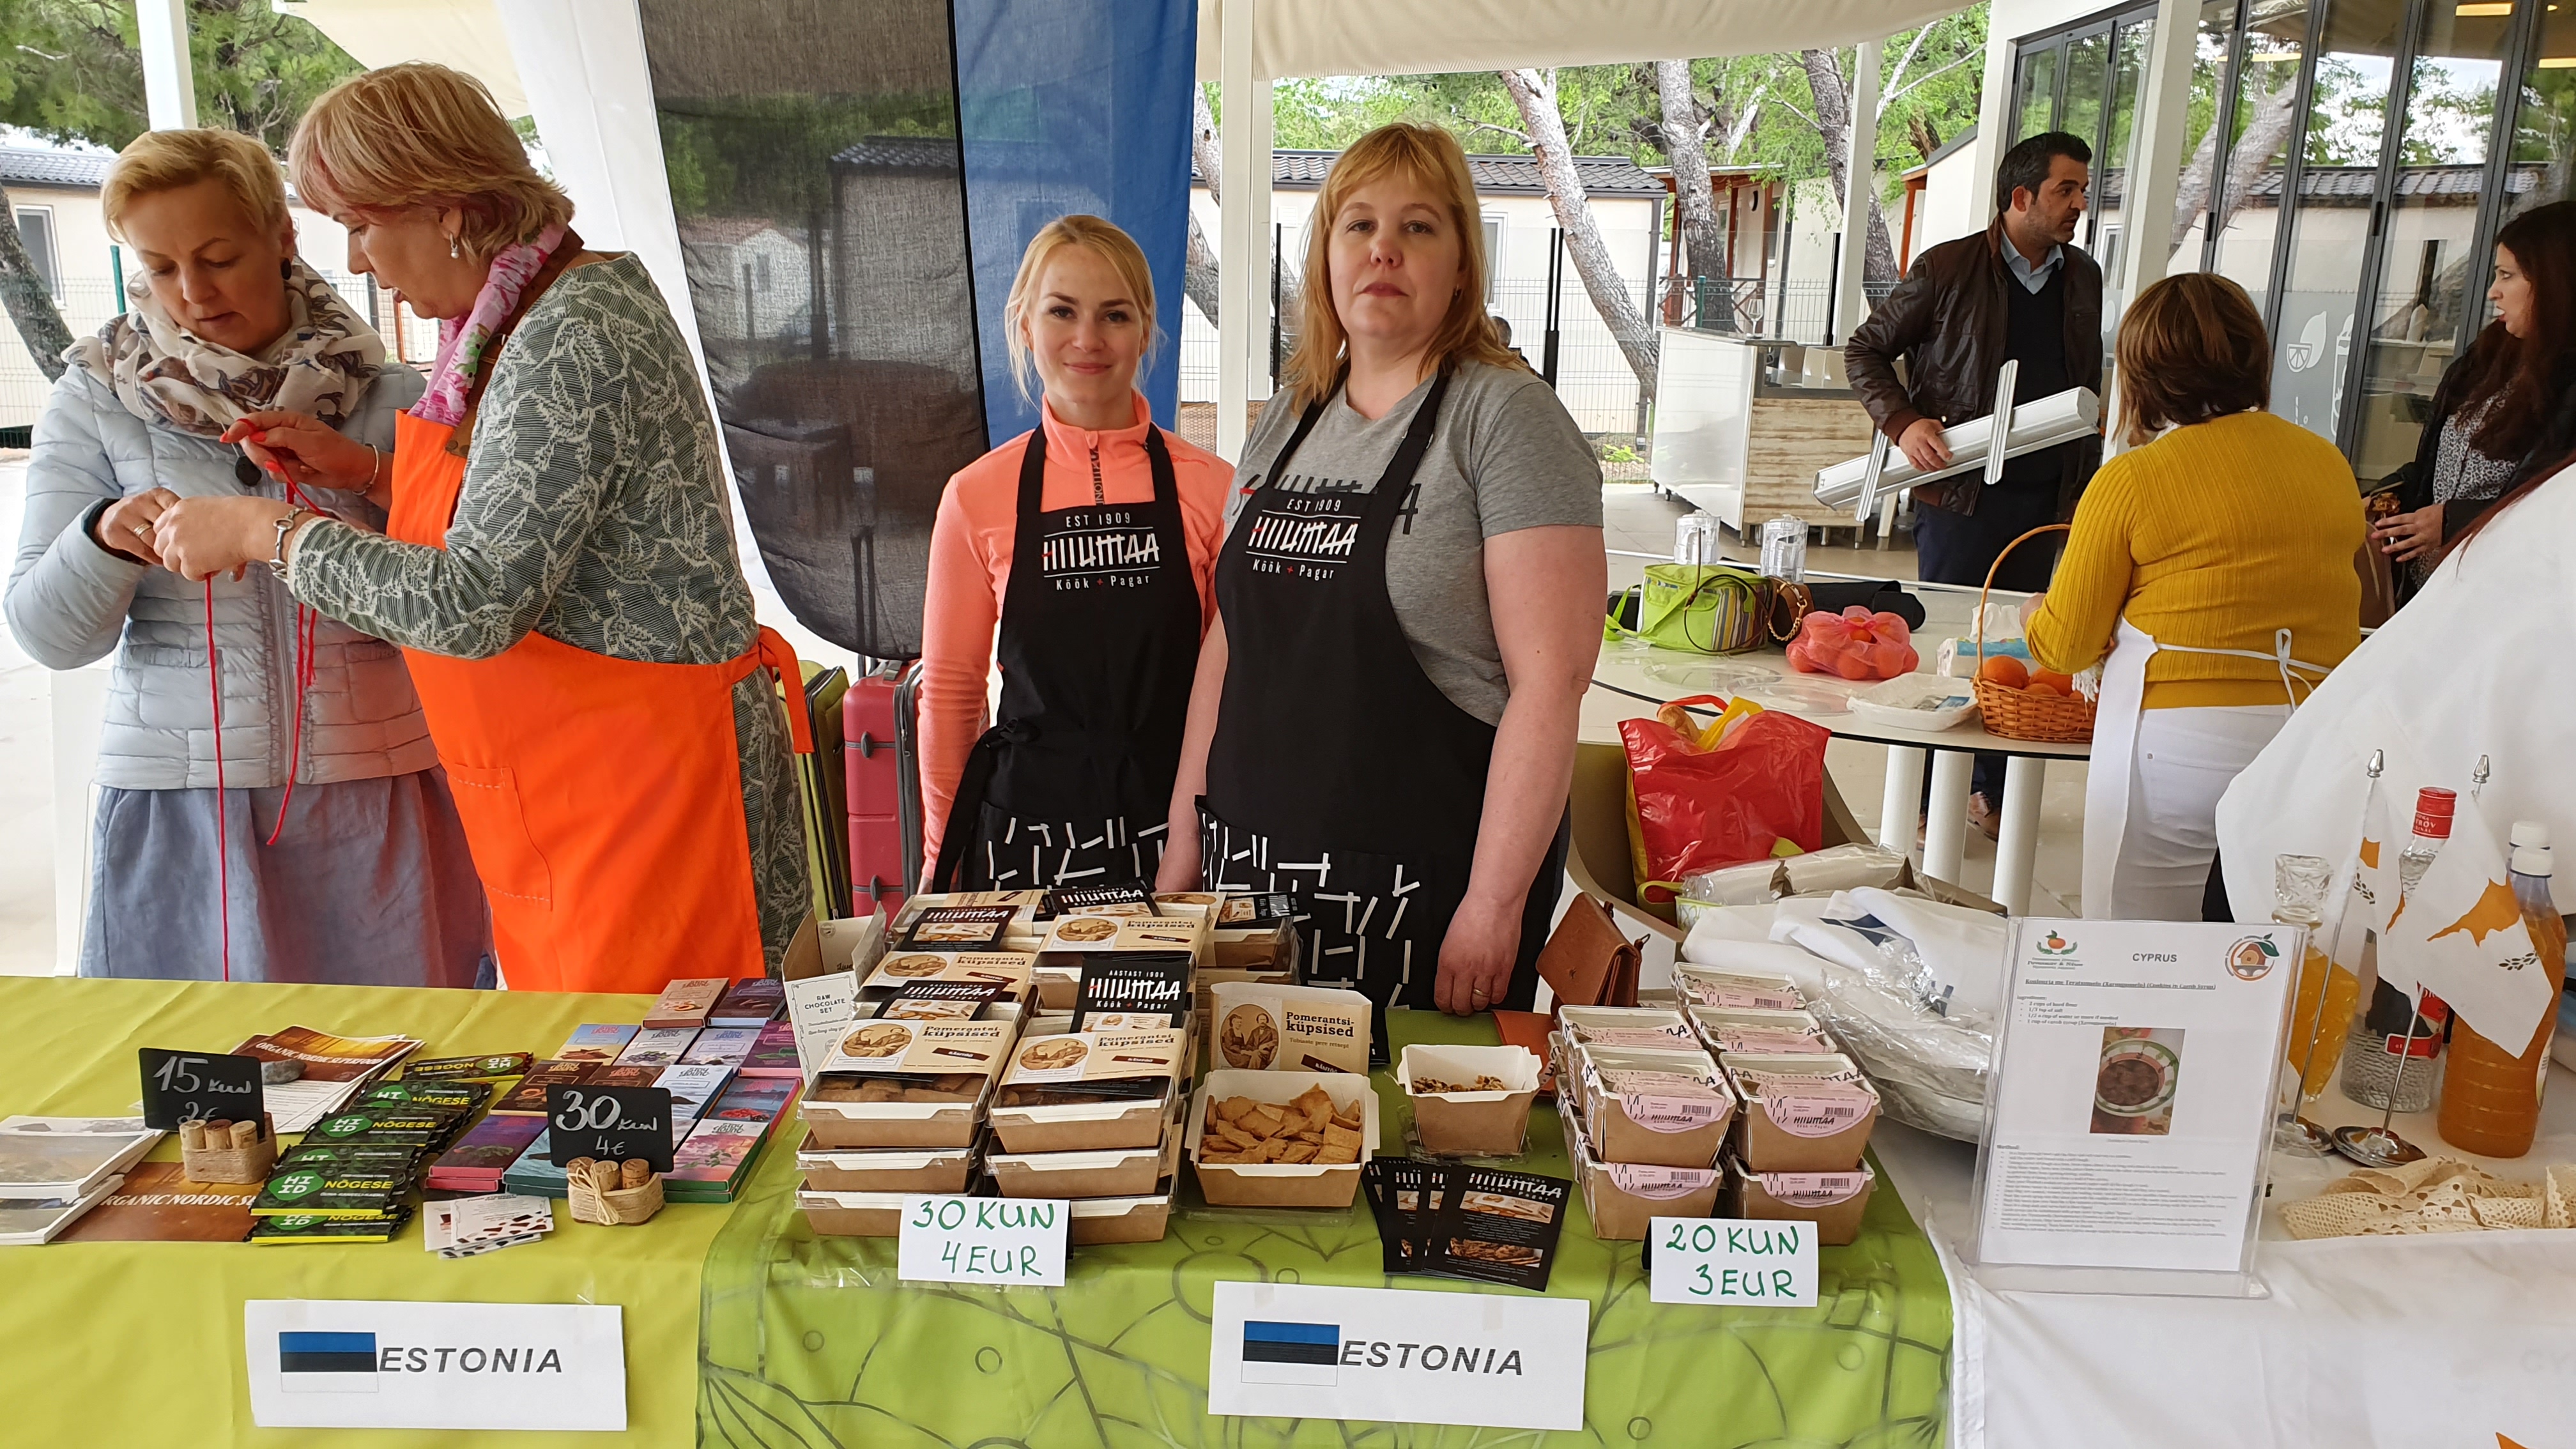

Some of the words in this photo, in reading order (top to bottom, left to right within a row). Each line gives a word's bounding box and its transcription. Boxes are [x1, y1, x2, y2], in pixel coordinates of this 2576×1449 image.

[1287, 498, 1311, 512] EST
[1315, 499, 1341, 512] 1909
[1066, 514, 1089, 527] EST
[1098, 512, 1130, 526] 1909
[1299, 564, 1335, 581] Pagar
[1110, 575, 1149, 588] Pagar
[2132, 953, 2177, 963] CYPRUS
[804, 998, 846, 1009] CHOCOLATE
[1137, 1001, 1167, 1011] Pagar
[1286, 1011, 1354, 1026] Pomerantsi-
[1285, 1020, 1354, 1037] küpsised
[1098, 1038, 1175, 1046] küpsised
[256, 1042, 299, 1058] ORGANIC
[153, 1055, 209, 1093] 15
[555, 1090, 622, 1131] 30
[284, 1176, 314, 1184] HI
[324, 1179, 394, 1189] NÕGESE
[278, 1184, 307, 1193] ID
[100, 1194, 171, 1206] RGANIC
[166, 1194, 240, 1206] NORDIC
[912, 1200, 966, 1230] 30
[976, 1201, 1055, 1230] KUN
[1666, 1223, 1715, 1252] 20
[1728, 1225, 1799, 1255] KUN
[966, 1245, 1043, 1276] EUR
[1721, 1269, 1797, 1298] EUR
[379, 1347, 562, 1373] ESTONIA
[1339, 1340, 1522, 1376] ESTONIA
